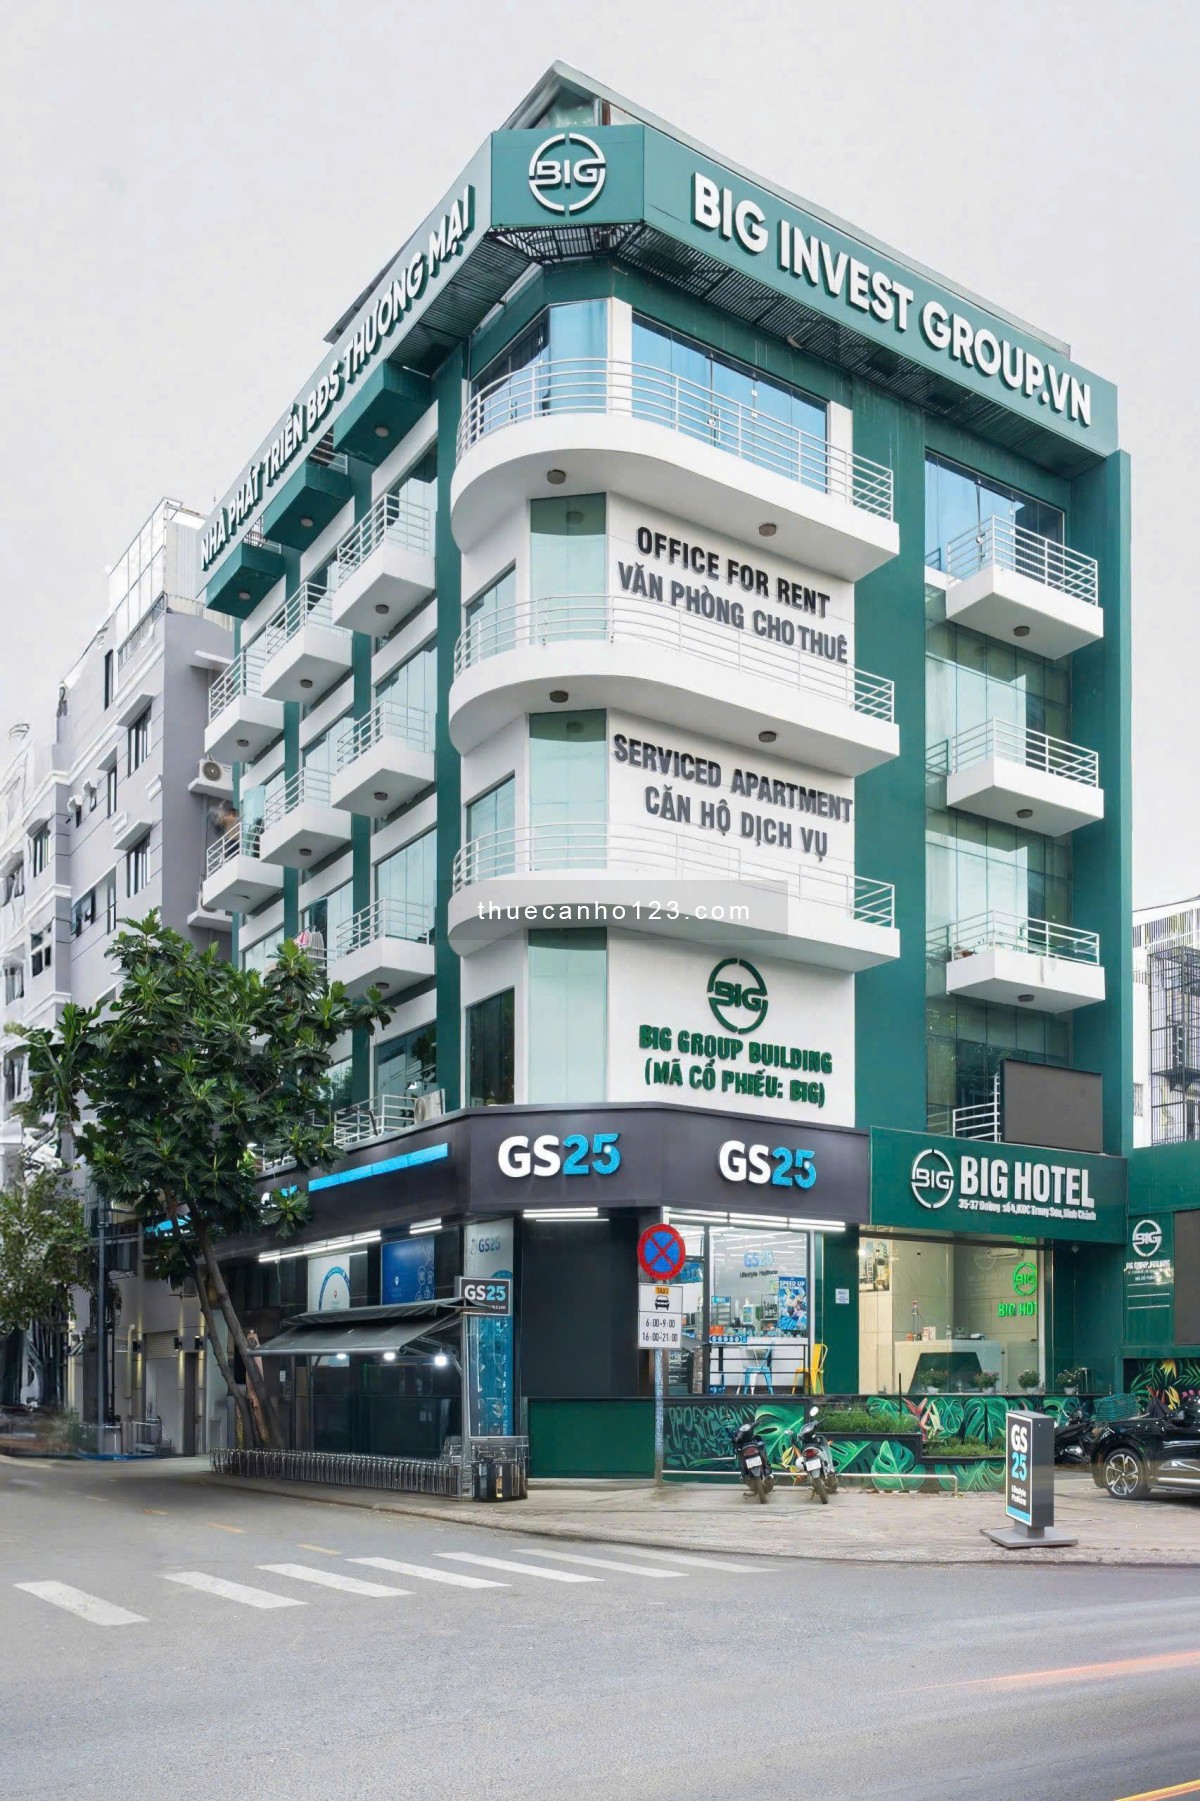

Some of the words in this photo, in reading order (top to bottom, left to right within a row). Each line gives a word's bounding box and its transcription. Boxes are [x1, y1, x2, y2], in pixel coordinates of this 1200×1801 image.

[695, 172, 768, 252] BIG
[781, 219, 913, 331] INVEST
[923, 301, 1091, 426] GROUP.VN
[200, 507, 227, 570] NHÀ
[228, 464, 261, 534] PHÁT
[263, 403, 304, 484] TRIỂN
[306, 360, 341, 431] BĐS
[344, 251, 424, 383] THƯƠNG
[429, 184, 471, 277] MẠI
[637, 526, 719, 580] OFFICE
[727, 558, 769, 597] FOR
[777, 577, 831, 618] RENT
[618, 561, 663, 601] VĂN
[671, 580, 744, 629] PHÒNG
[753, 610, 795, 645] CHO
[798, 624, 848, 664] THUÊ
[613, 733, 722, 788] SERVICED
[730, 768, 853, 823] APARTMENT
[645, 784, 691, 823] CĂN
[701, 798, 731, 836] HỘ
[741, 811, 792, 848] DỊCH
[800, 826, 828, 862] VỤ
[639, 1024, 672, 1052] BIG
[677, 1030, 744, 1060] GROUP
[749, 1041, 833, 1074] BUILDING
[645, 1057, 683, 1087] (MÃ
[689, 1058, 716, 1091] CỔ
[721, 1068, 784, 1099] PHIẾU:
[790, 1078, 826, 1109] BIG)
[497, 1133, 622, 1178] GS25
[718, 1139, 817, 1190] GS25
[960, 1155, 1008, 1199] BIG
[1014, 1161, 1095, 1209] HOTEL
[478, 1237, 501, 1253] GS25
[464, 1284, 507, 1302] GS25
[1010, 1424, 1028, 1454] GS
[1011, 1451, 1027, 1482] 25
